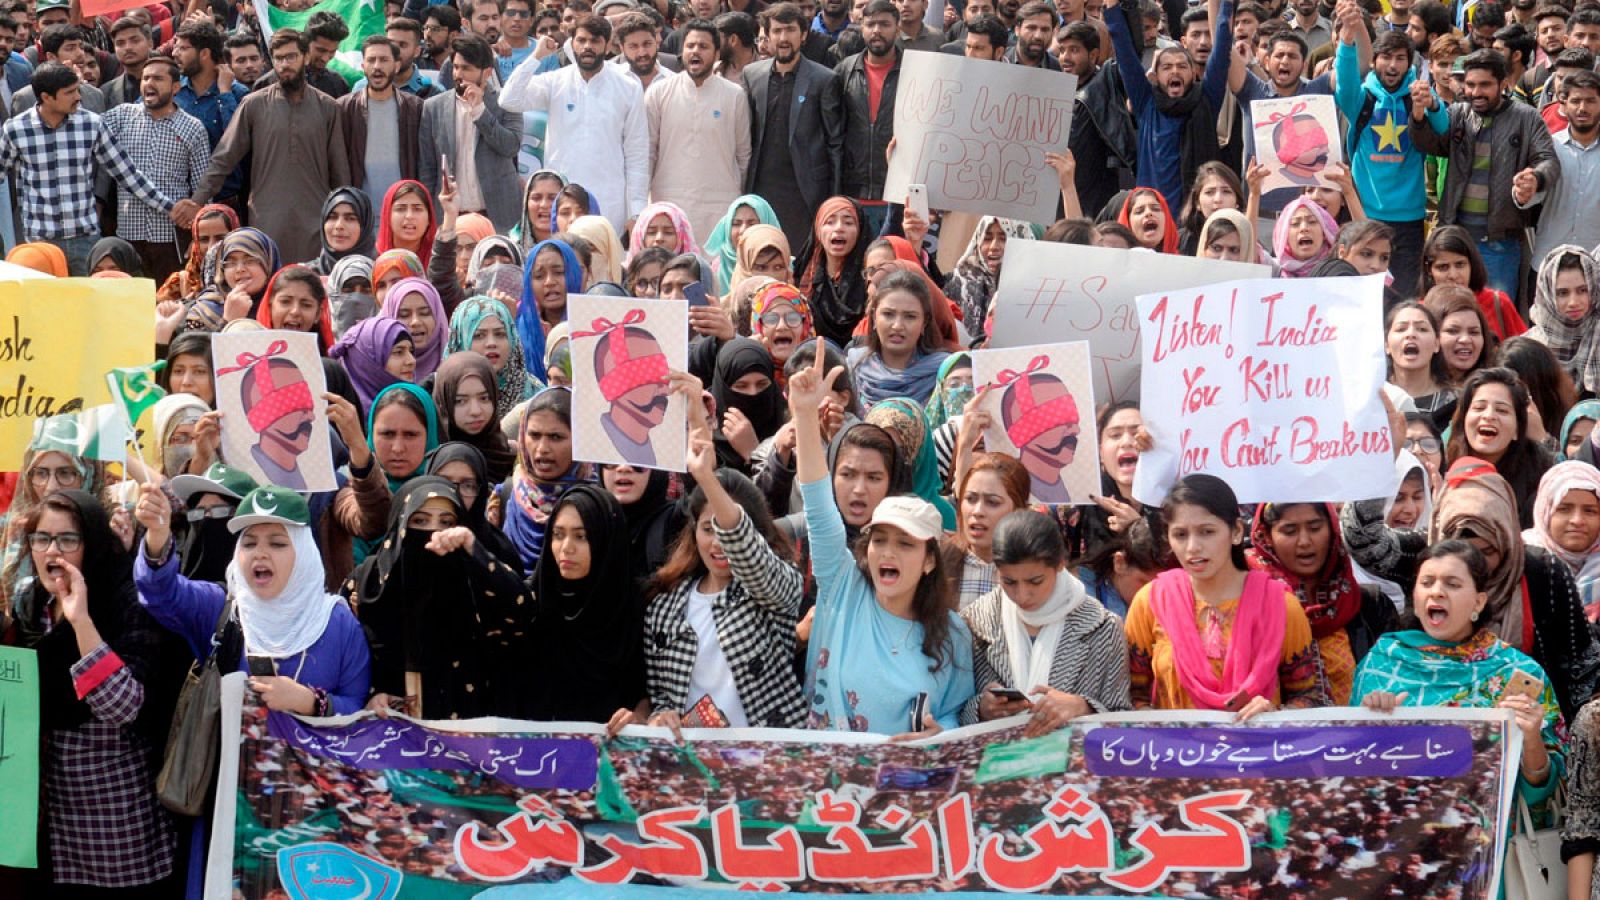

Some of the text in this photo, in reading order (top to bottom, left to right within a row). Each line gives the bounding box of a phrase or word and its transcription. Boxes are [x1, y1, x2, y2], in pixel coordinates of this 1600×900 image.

[903, 79, 1074, 145] WE WANT
[914, 131, 1046, 206] PEACE
[0, 315, 34, 362] sh
[1148, 288, 1338, 363] Listen! India
[1182, 366, 1221, 416] You
[1239, 356, 1293, 403] Kill
[1305, 375, 1331, 399] us
[1177, 428, 1209, 480] You
[355, 725, 413, 764] کشمیر
[480, 746, 524, 775] بستی
[1101, 735, 1126, 762] کا
[1178, 735, 1232, 767] خون
[1227, 745, 1269, 772] ہے
[1273, 739, 1327, 762] سستا
[1323, 742, 1378, 765] بہت
[1380, 745, 1422, 770] ہے
[1425, 737, 1455, 760] سنا
[455, 784, 1253, 893] کرش انڈیا کرش
